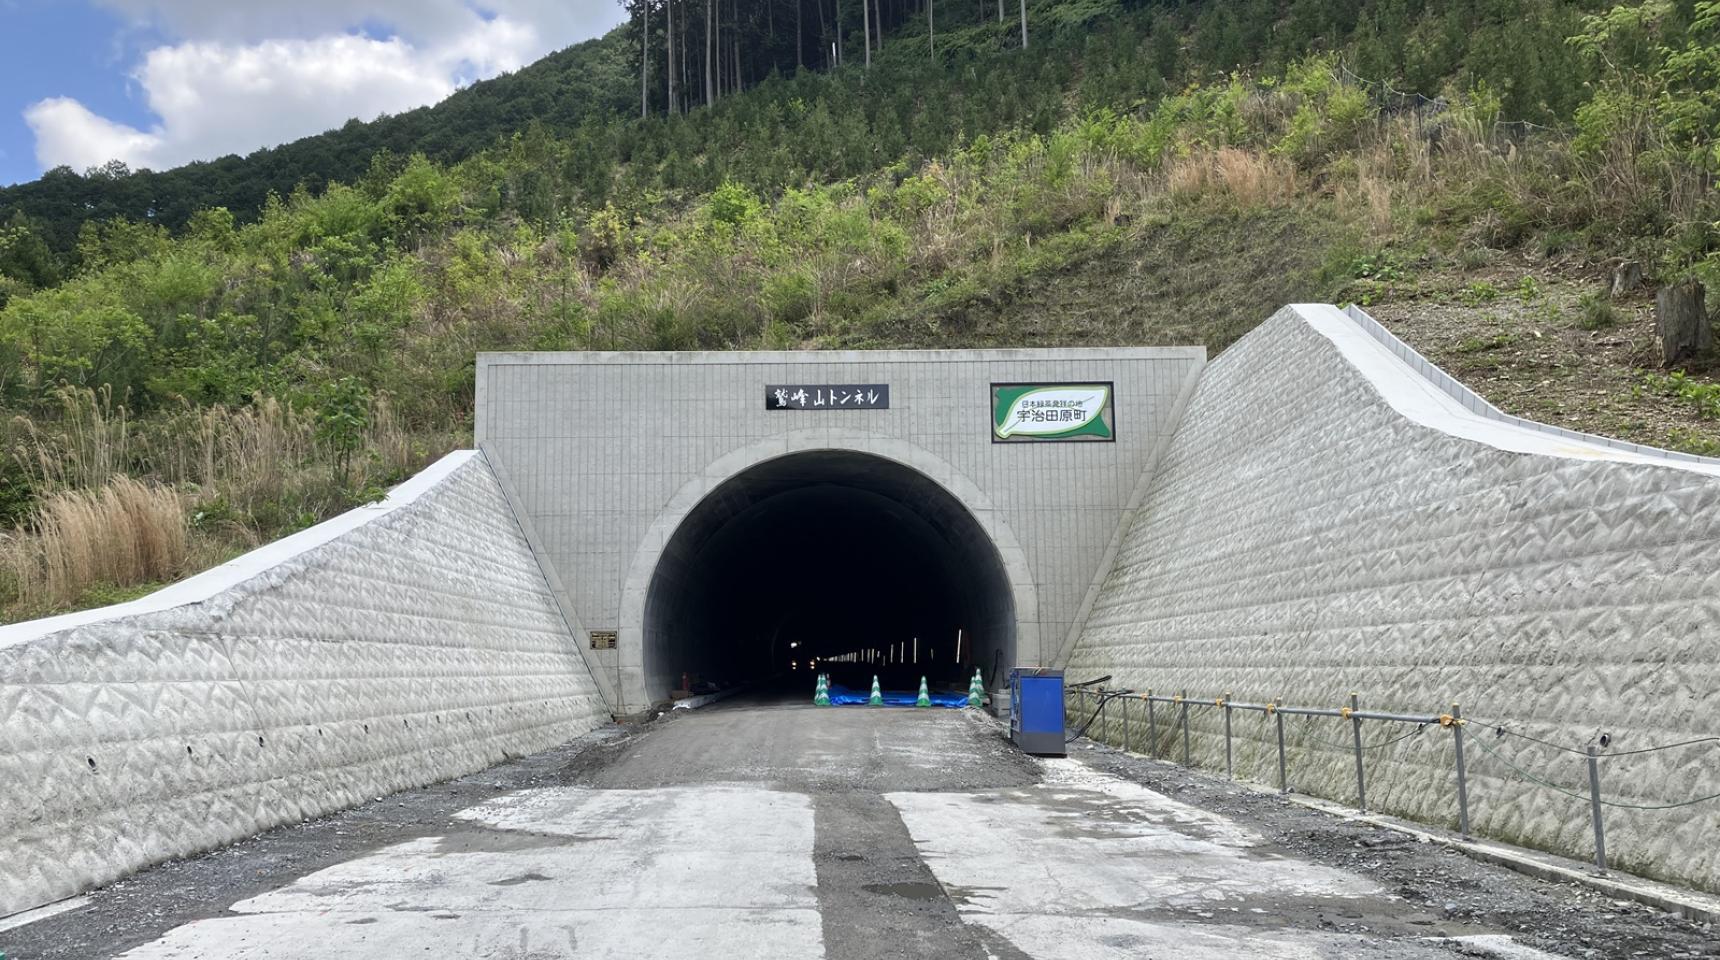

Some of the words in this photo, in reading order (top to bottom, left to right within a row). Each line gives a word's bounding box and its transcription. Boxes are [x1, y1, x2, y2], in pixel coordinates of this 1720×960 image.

[774, 388, 880, 407] 鷲峰山トンネル
[1016, 409, 1087, 422] 宇治田原町
